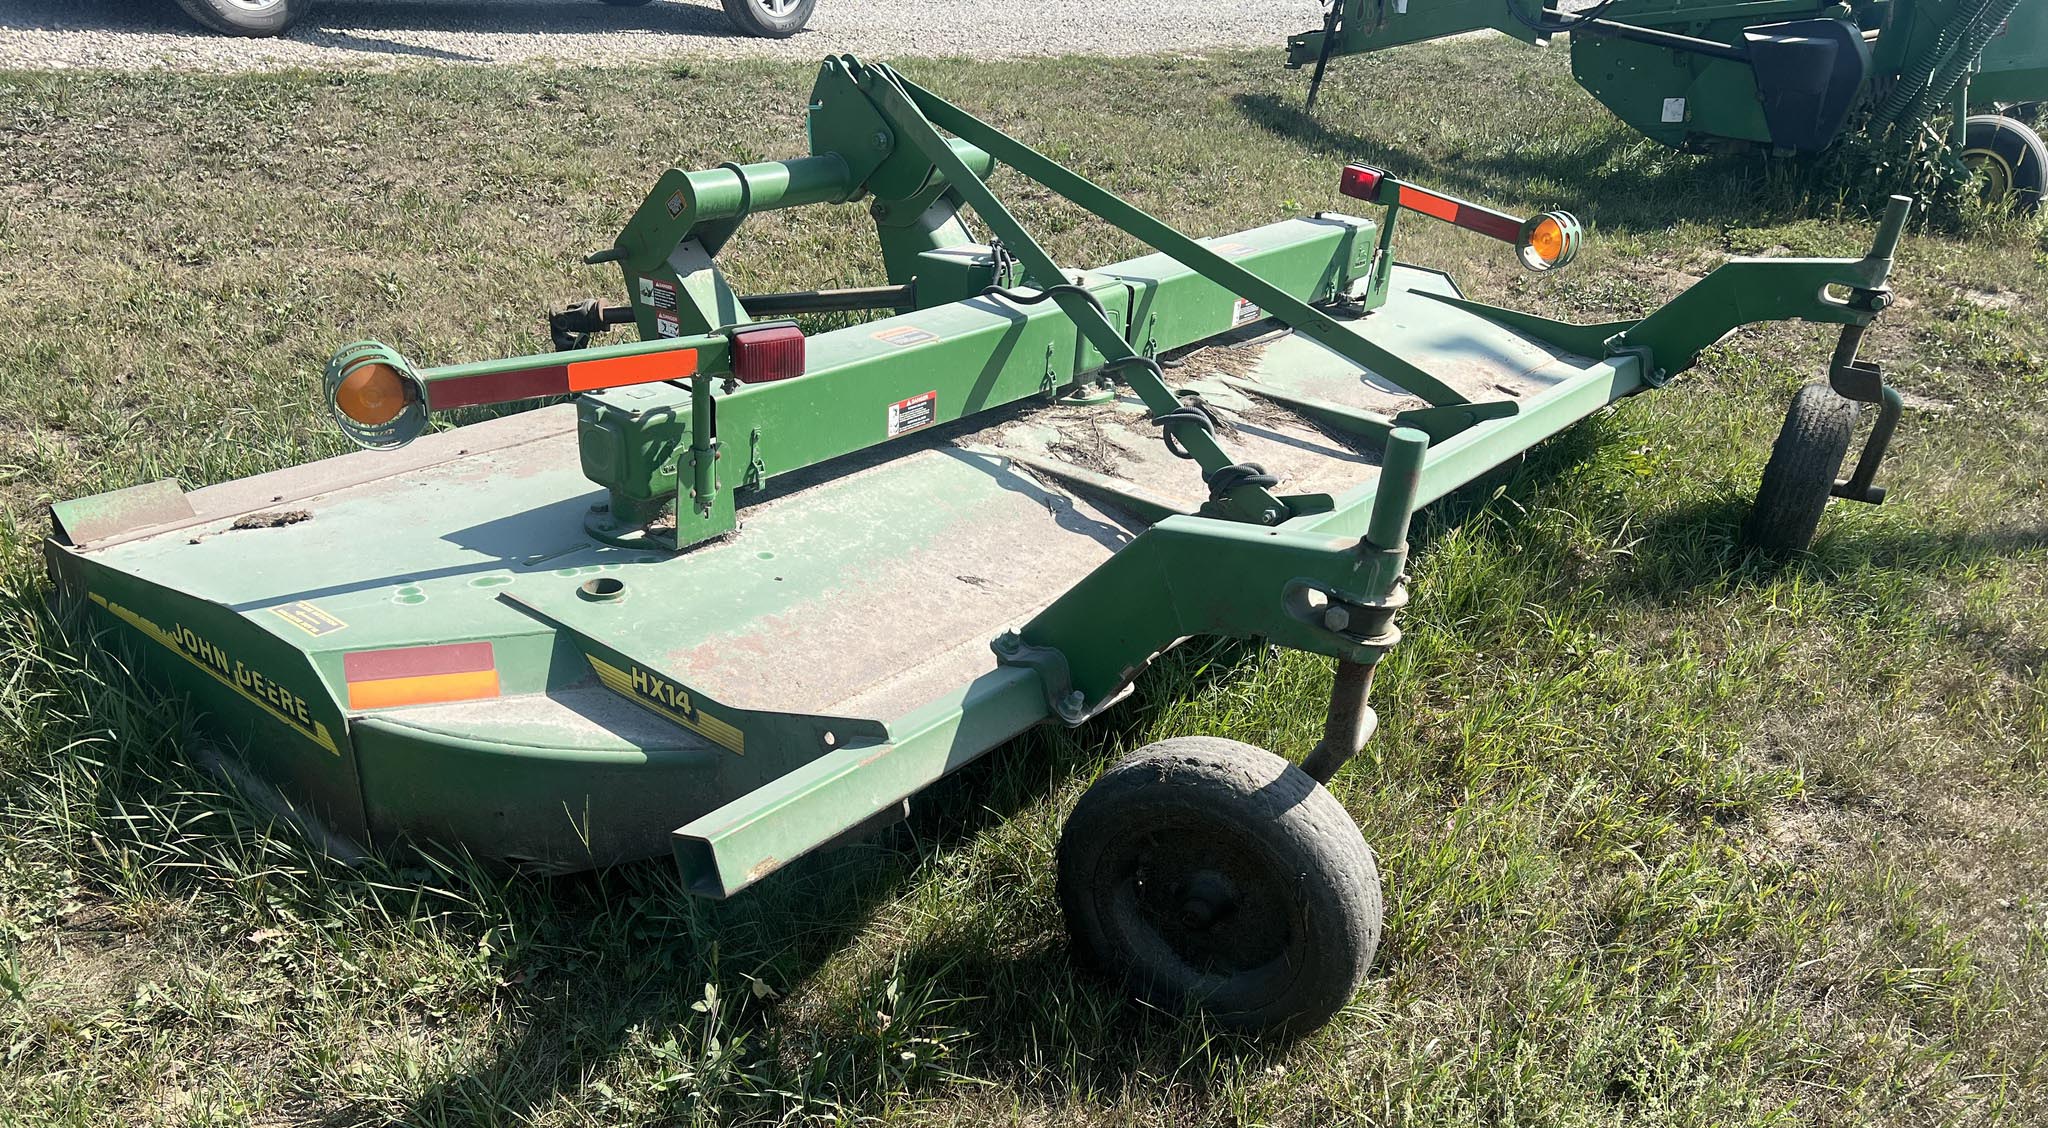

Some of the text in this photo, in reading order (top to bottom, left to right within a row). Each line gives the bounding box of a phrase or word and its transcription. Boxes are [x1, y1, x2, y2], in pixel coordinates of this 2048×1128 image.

[172, 622, 310, 724] JOHN DEERE
[631, 665, 692, 715] HX14
